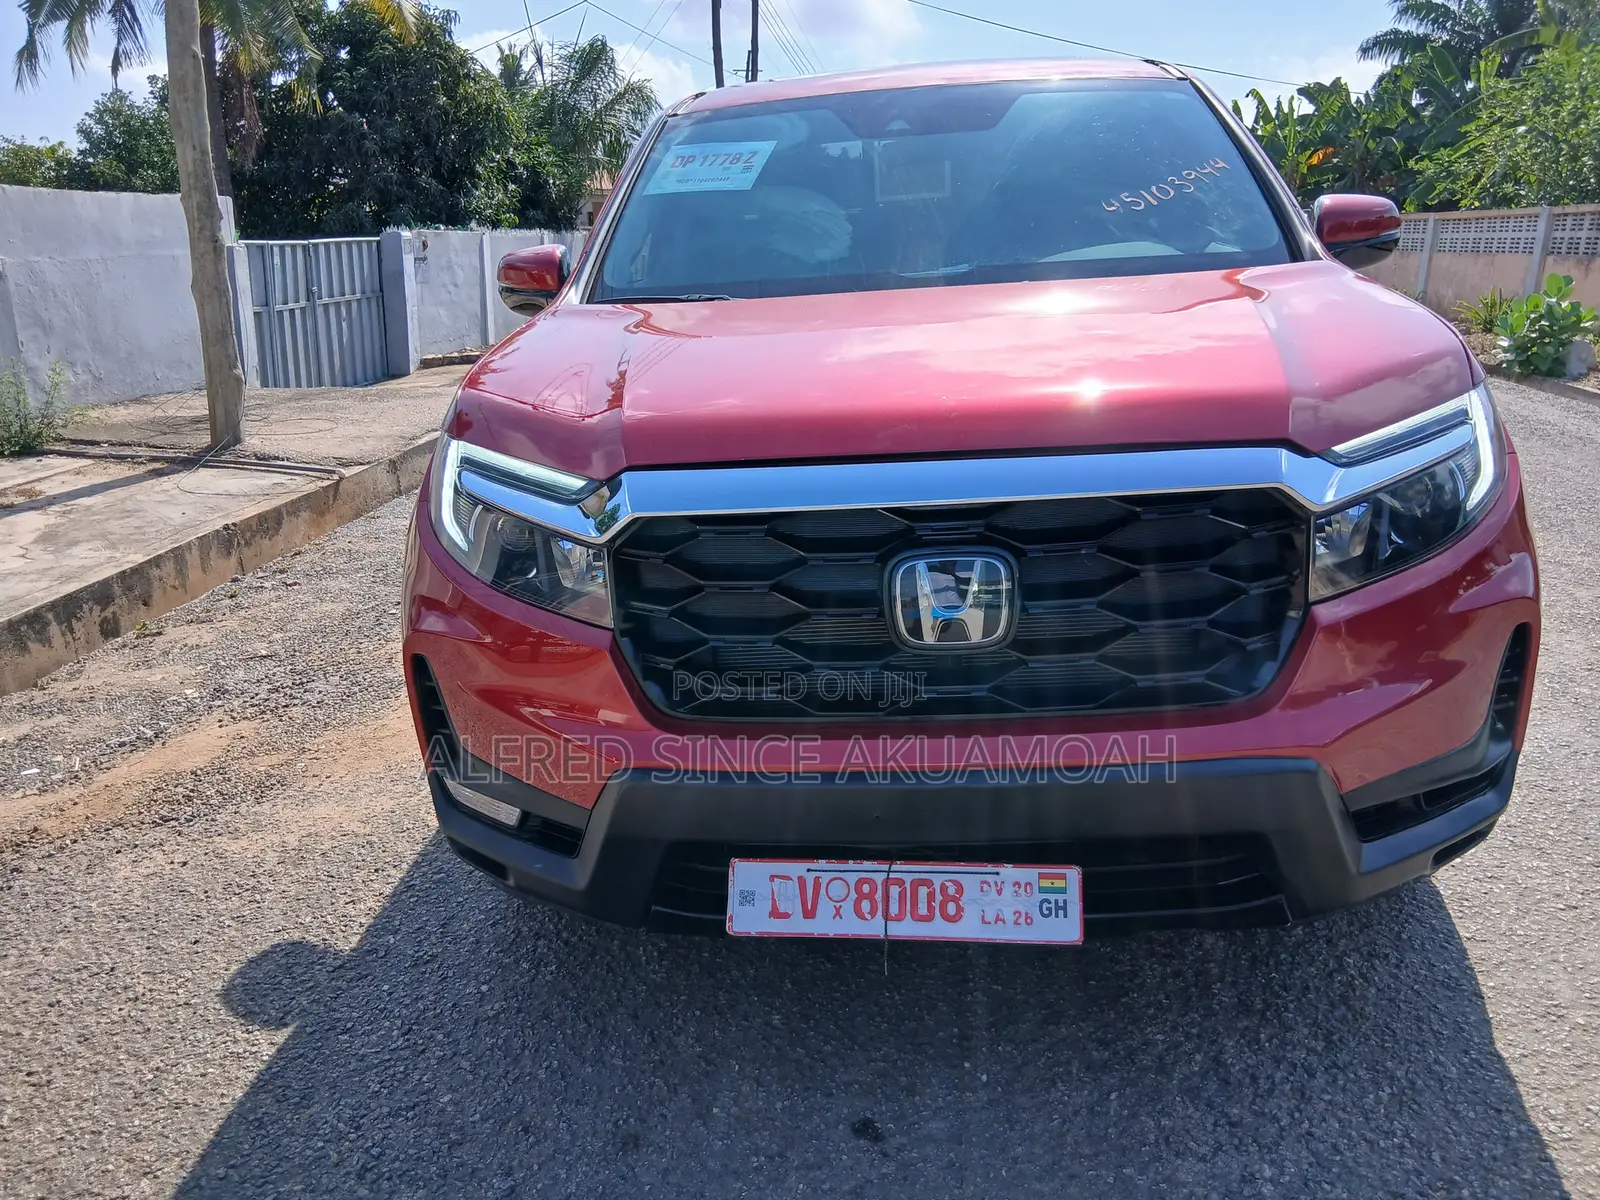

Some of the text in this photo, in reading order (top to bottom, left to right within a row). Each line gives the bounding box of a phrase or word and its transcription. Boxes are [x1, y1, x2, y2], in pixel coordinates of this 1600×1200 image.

[670, 151, 758, 168] DP 1778 Z
[1101, 157, 1231, 213] 45103944
[980, 880, 1005, 896] DV
[769, 875, 822, 919] DV
[853, 877, 965, 923] 8008
[1038, 898, 1068, 918] GH
[981, 909, 1006, 925] LA
